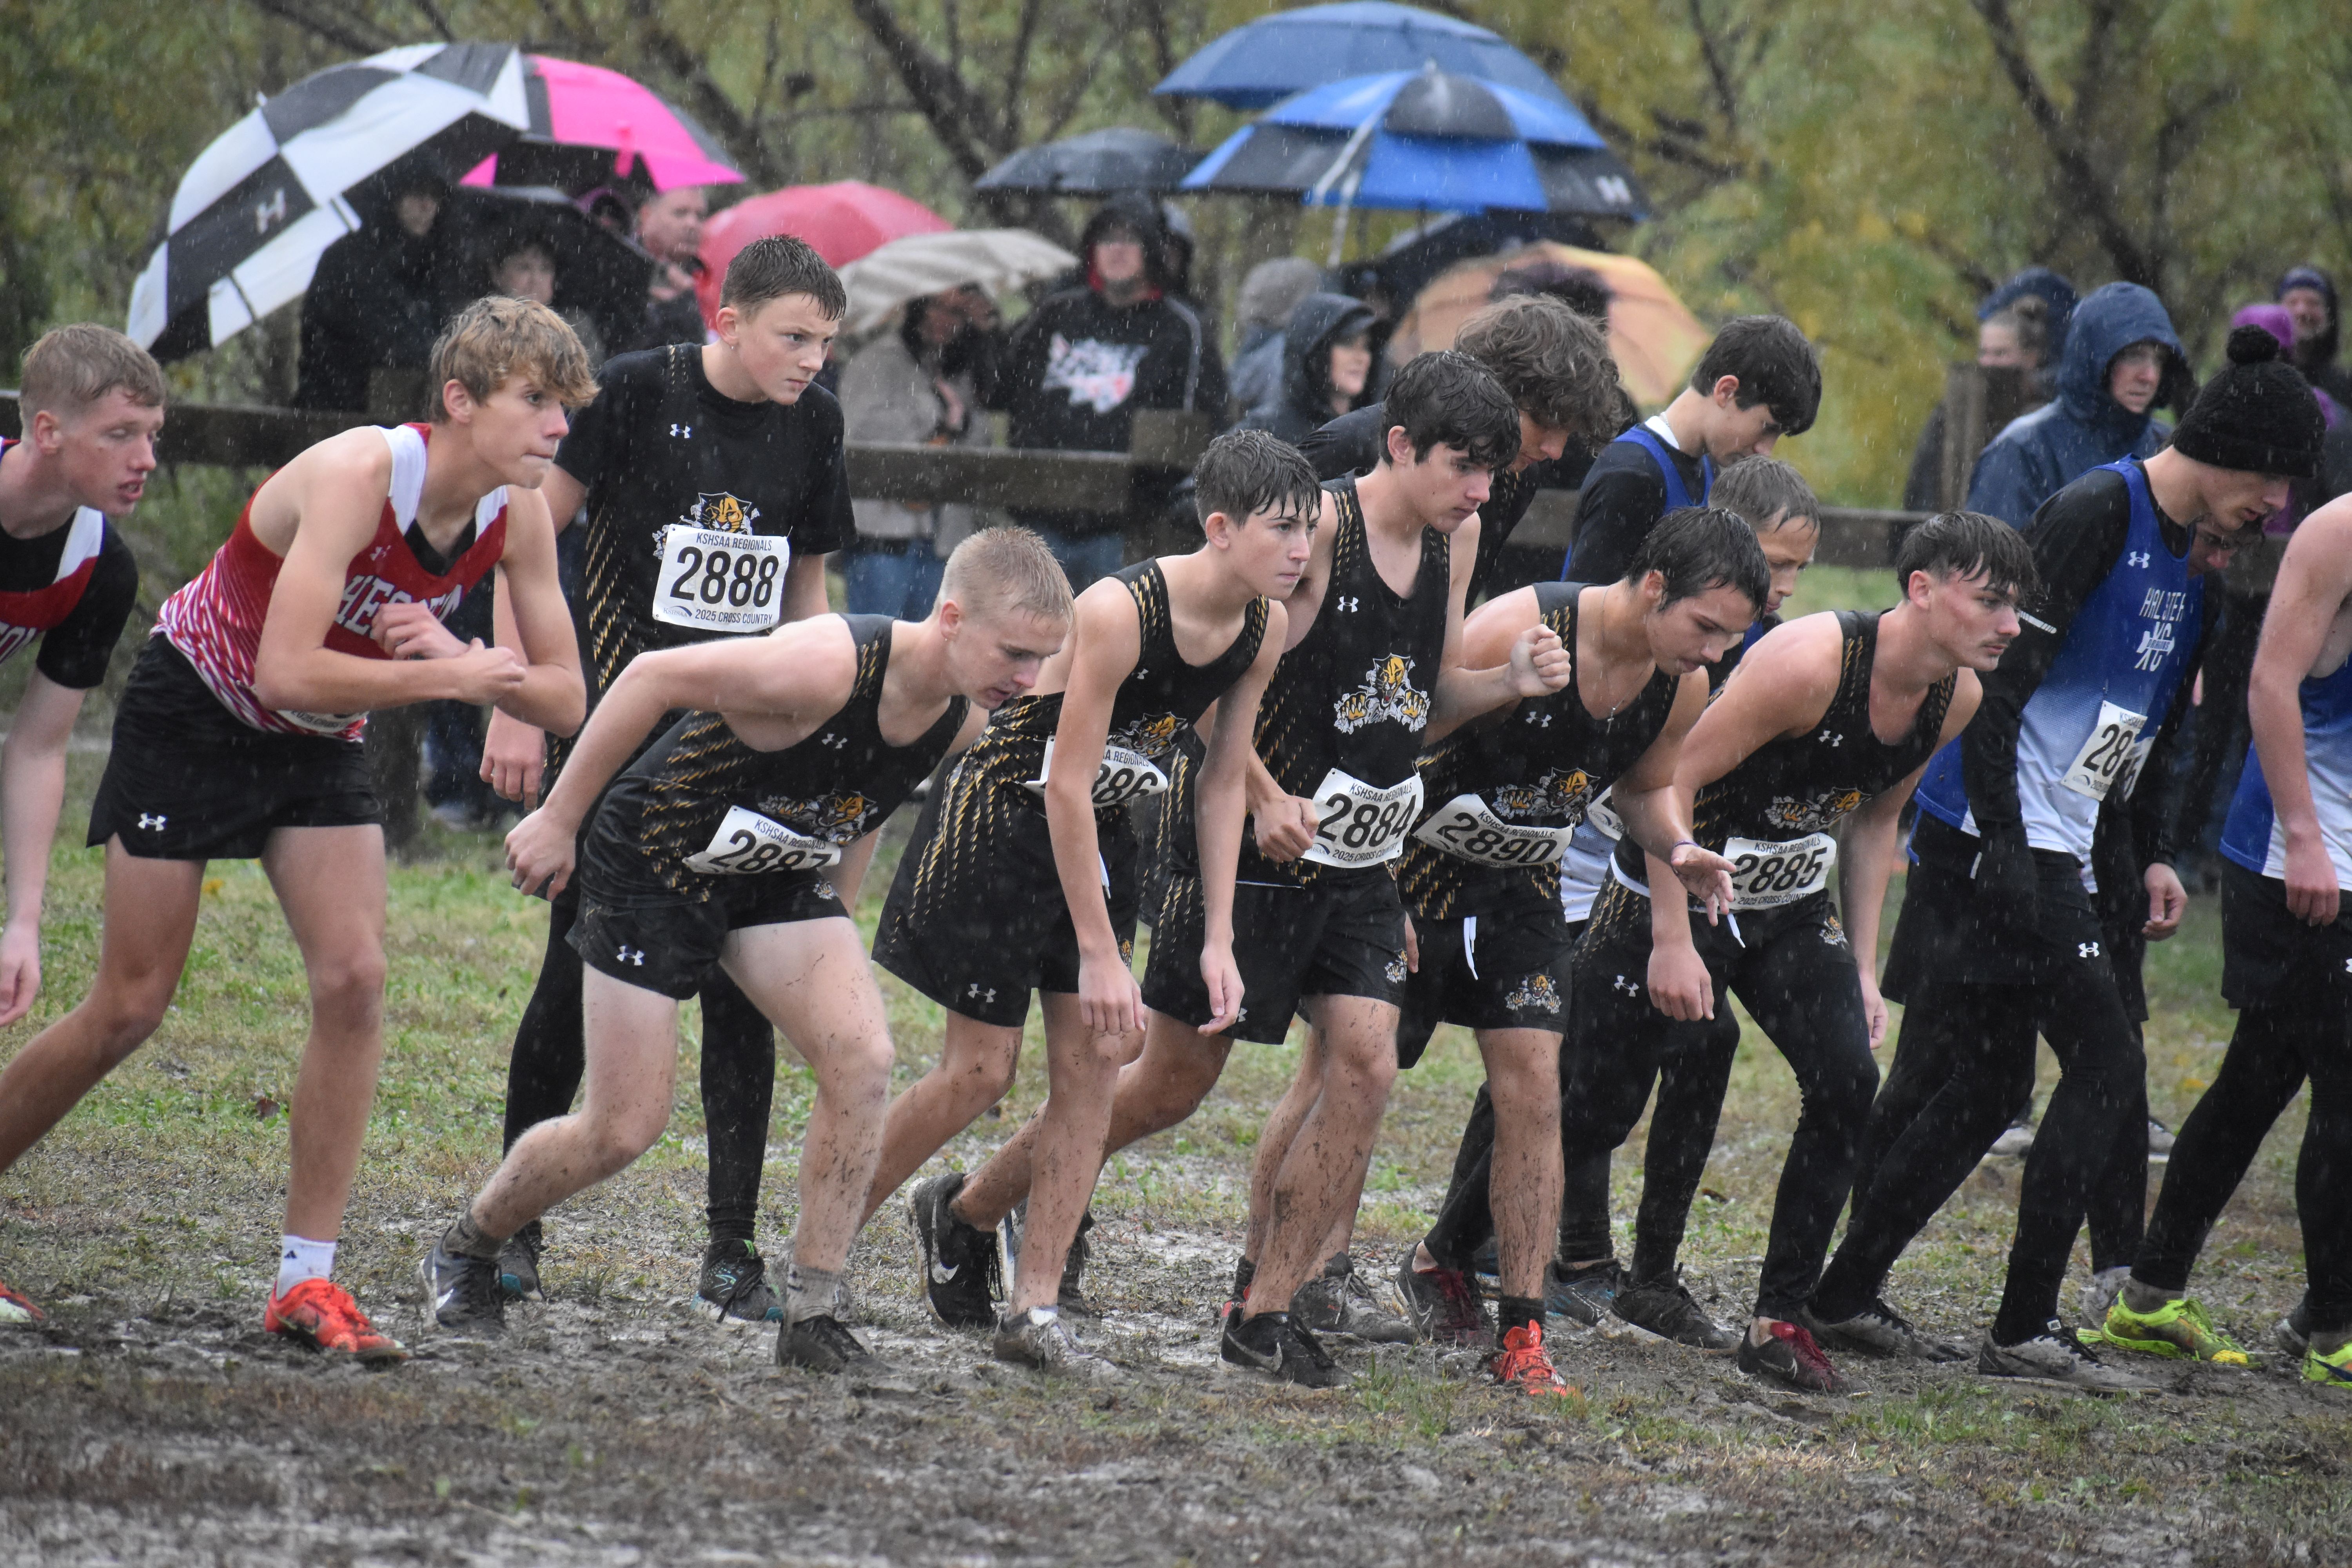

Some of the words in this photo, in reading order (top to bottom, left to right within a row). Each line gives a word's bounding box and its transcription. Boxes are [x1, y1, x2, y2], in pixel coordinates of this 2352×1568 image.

[696, 533, 730, 548] KSHSAA
[732, 537, 772, 551] REGIONALS
[670, 546, 779, 608] 2888
[695, 609, 717, 621] 2025
[718, 612, 741, 623] CROSS
[742, 613, 773, 624] COUNTRY
[1113, 751, 1149, 767] REGIONALS
[1349, 783, 1383, 802] KSHSAA
[1383, 782, 1412, 802] REGIONALS
[1316, 793, 1416, 848] 2884
[1477, 810, 1509, 834] KSHSAA
[1509, 828, 1555, 838] REGIONALS
[754, 819, 789, 844] KSHSAA
[788, 837, 826, 850] REGIONALS
[1436, 812, 1557, 863] 2890
[1754, 842, 1788, 855] KSHSAA
[1788, 835, 1821, 853] REGIONALS
[1332, 849, 1356, 862] 2025
[1354, 851, 1376, 862] CROSS
[1730, 846, 1828, 894] 2885
[1737, 897, 1758, 905] 2025
[1758, 895, 1781, 905] CROSS
